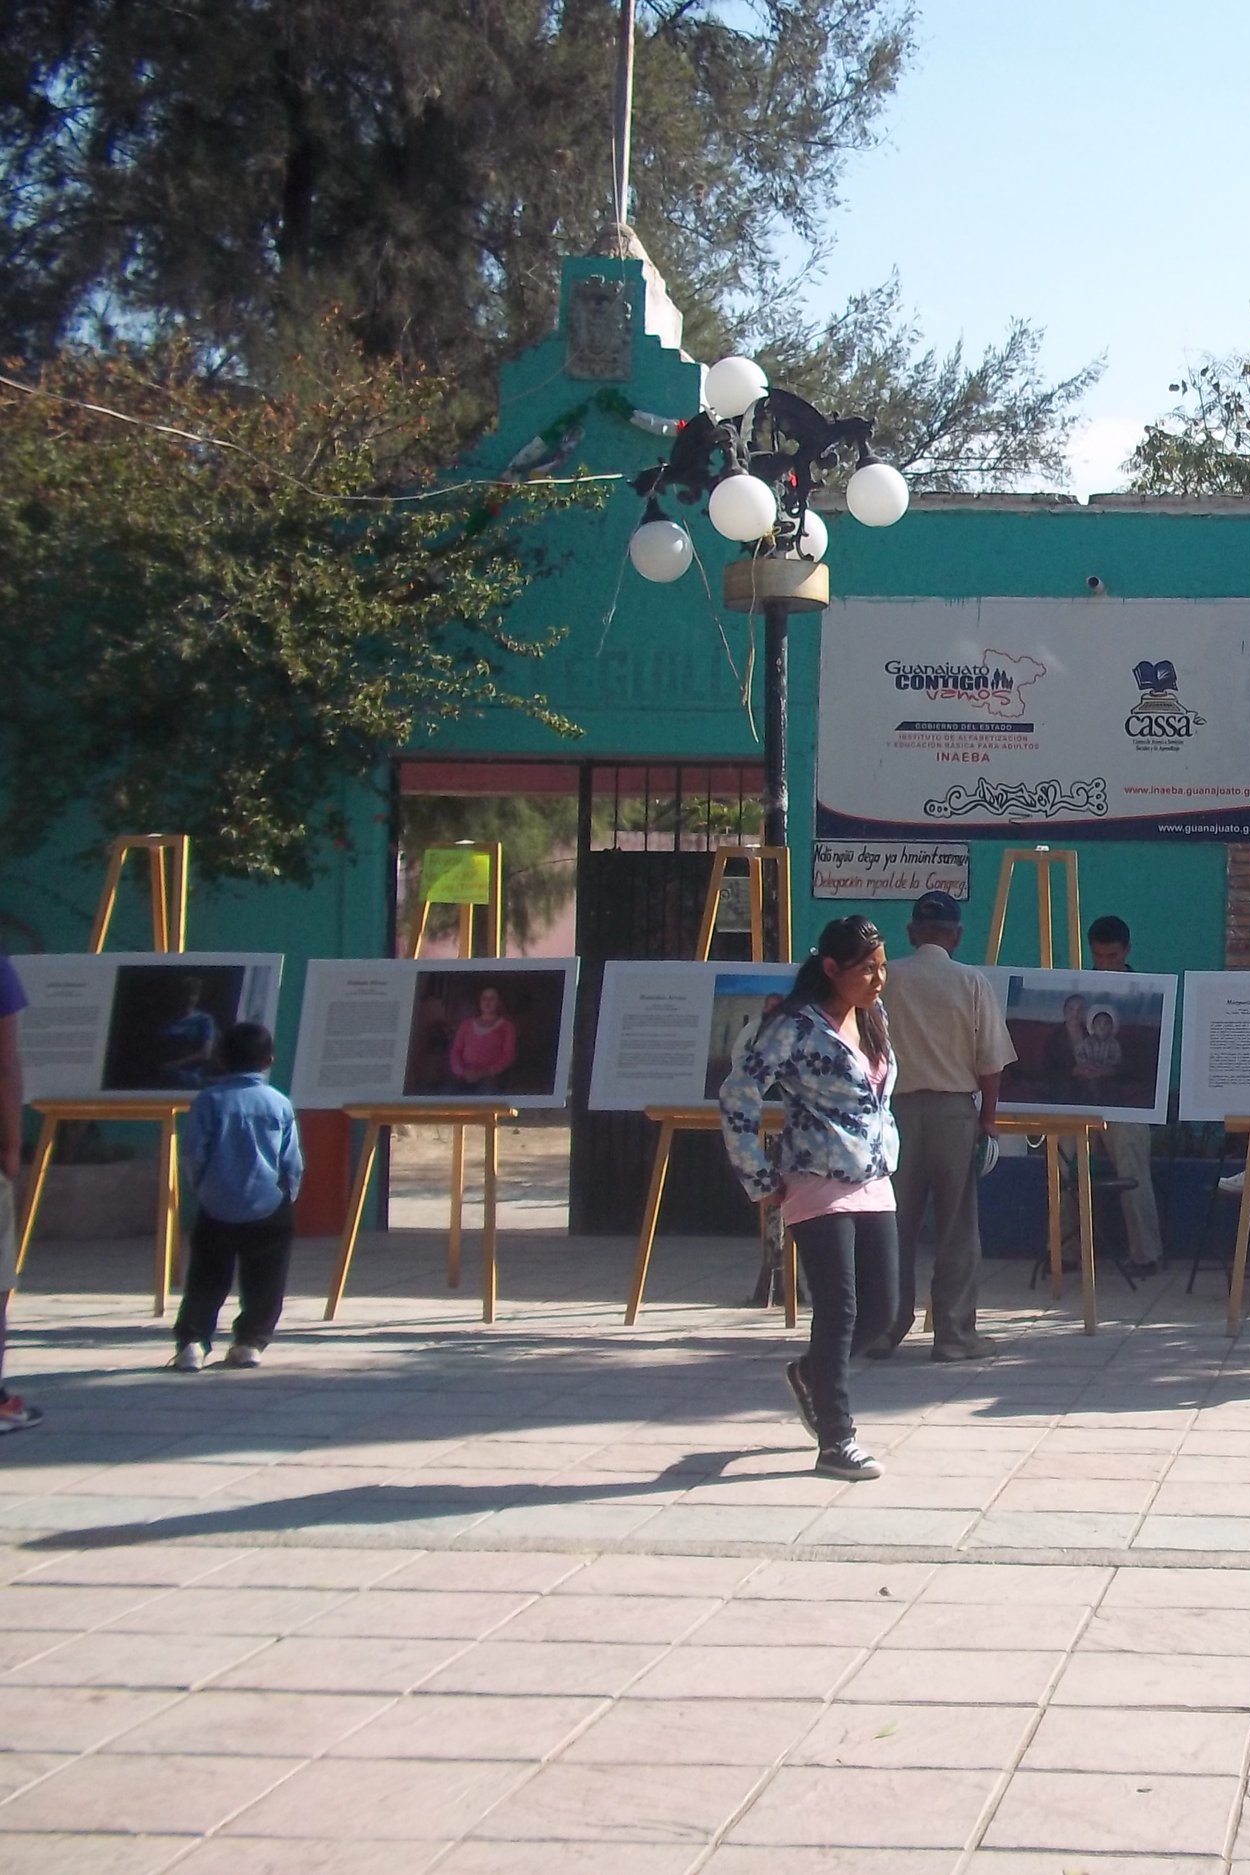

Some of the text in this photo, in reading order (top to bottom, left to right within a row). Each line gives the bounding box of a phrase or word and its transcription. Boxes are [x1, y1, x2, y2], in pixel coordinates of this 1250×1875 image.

[885, 660, 990, 677] Guanajuato
[895, 675, 988, 690] CONTIGO
[926, 689, 1011, 705] vamos
[1125, 715, 1193, 738] cassa
[936, 752, 990, 763] INAEBA
[882, 853, 898, 871] ya
